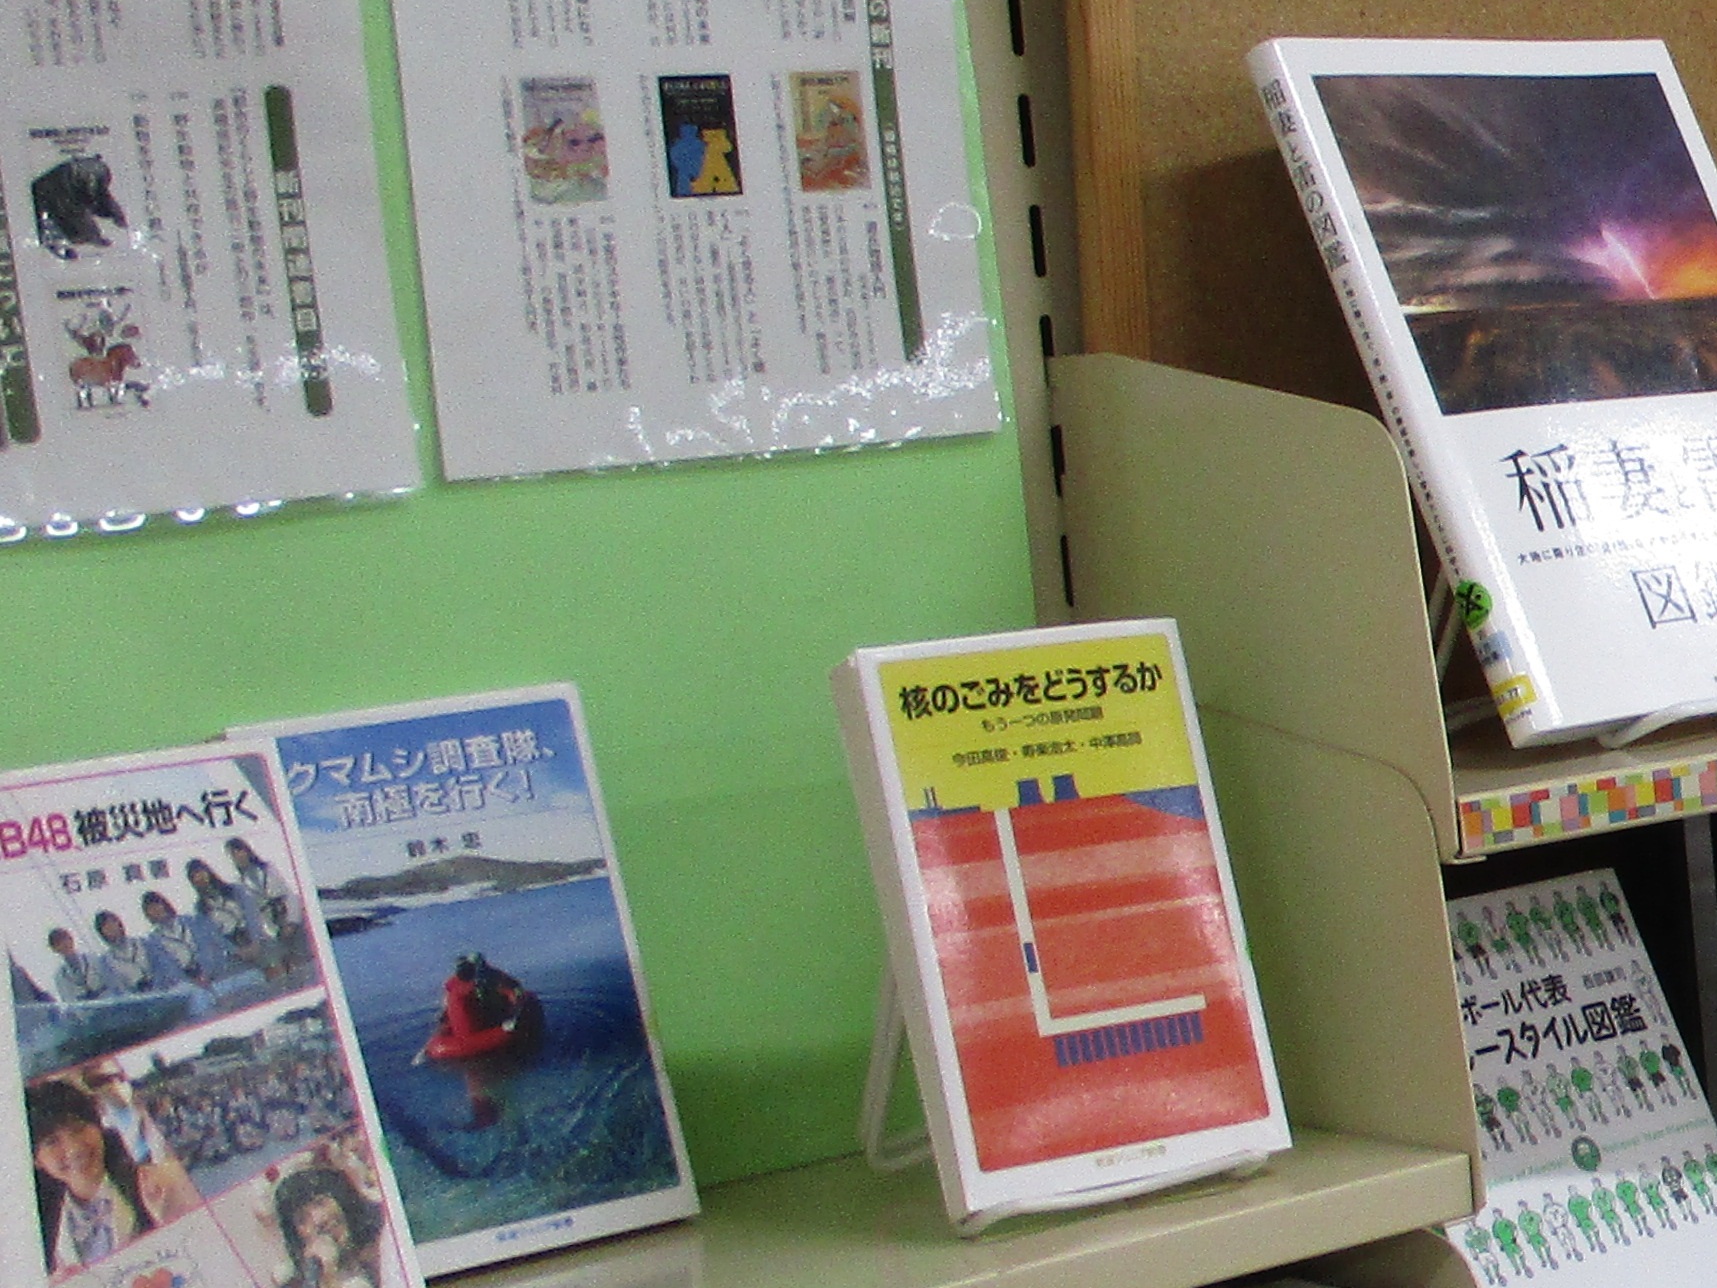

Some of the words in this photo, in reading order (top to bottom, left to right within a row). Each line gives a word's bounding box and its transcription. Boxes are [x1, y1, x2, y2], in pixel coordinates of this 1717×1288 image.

[898, 659, 1164, 719] 核のごみをどうするか
